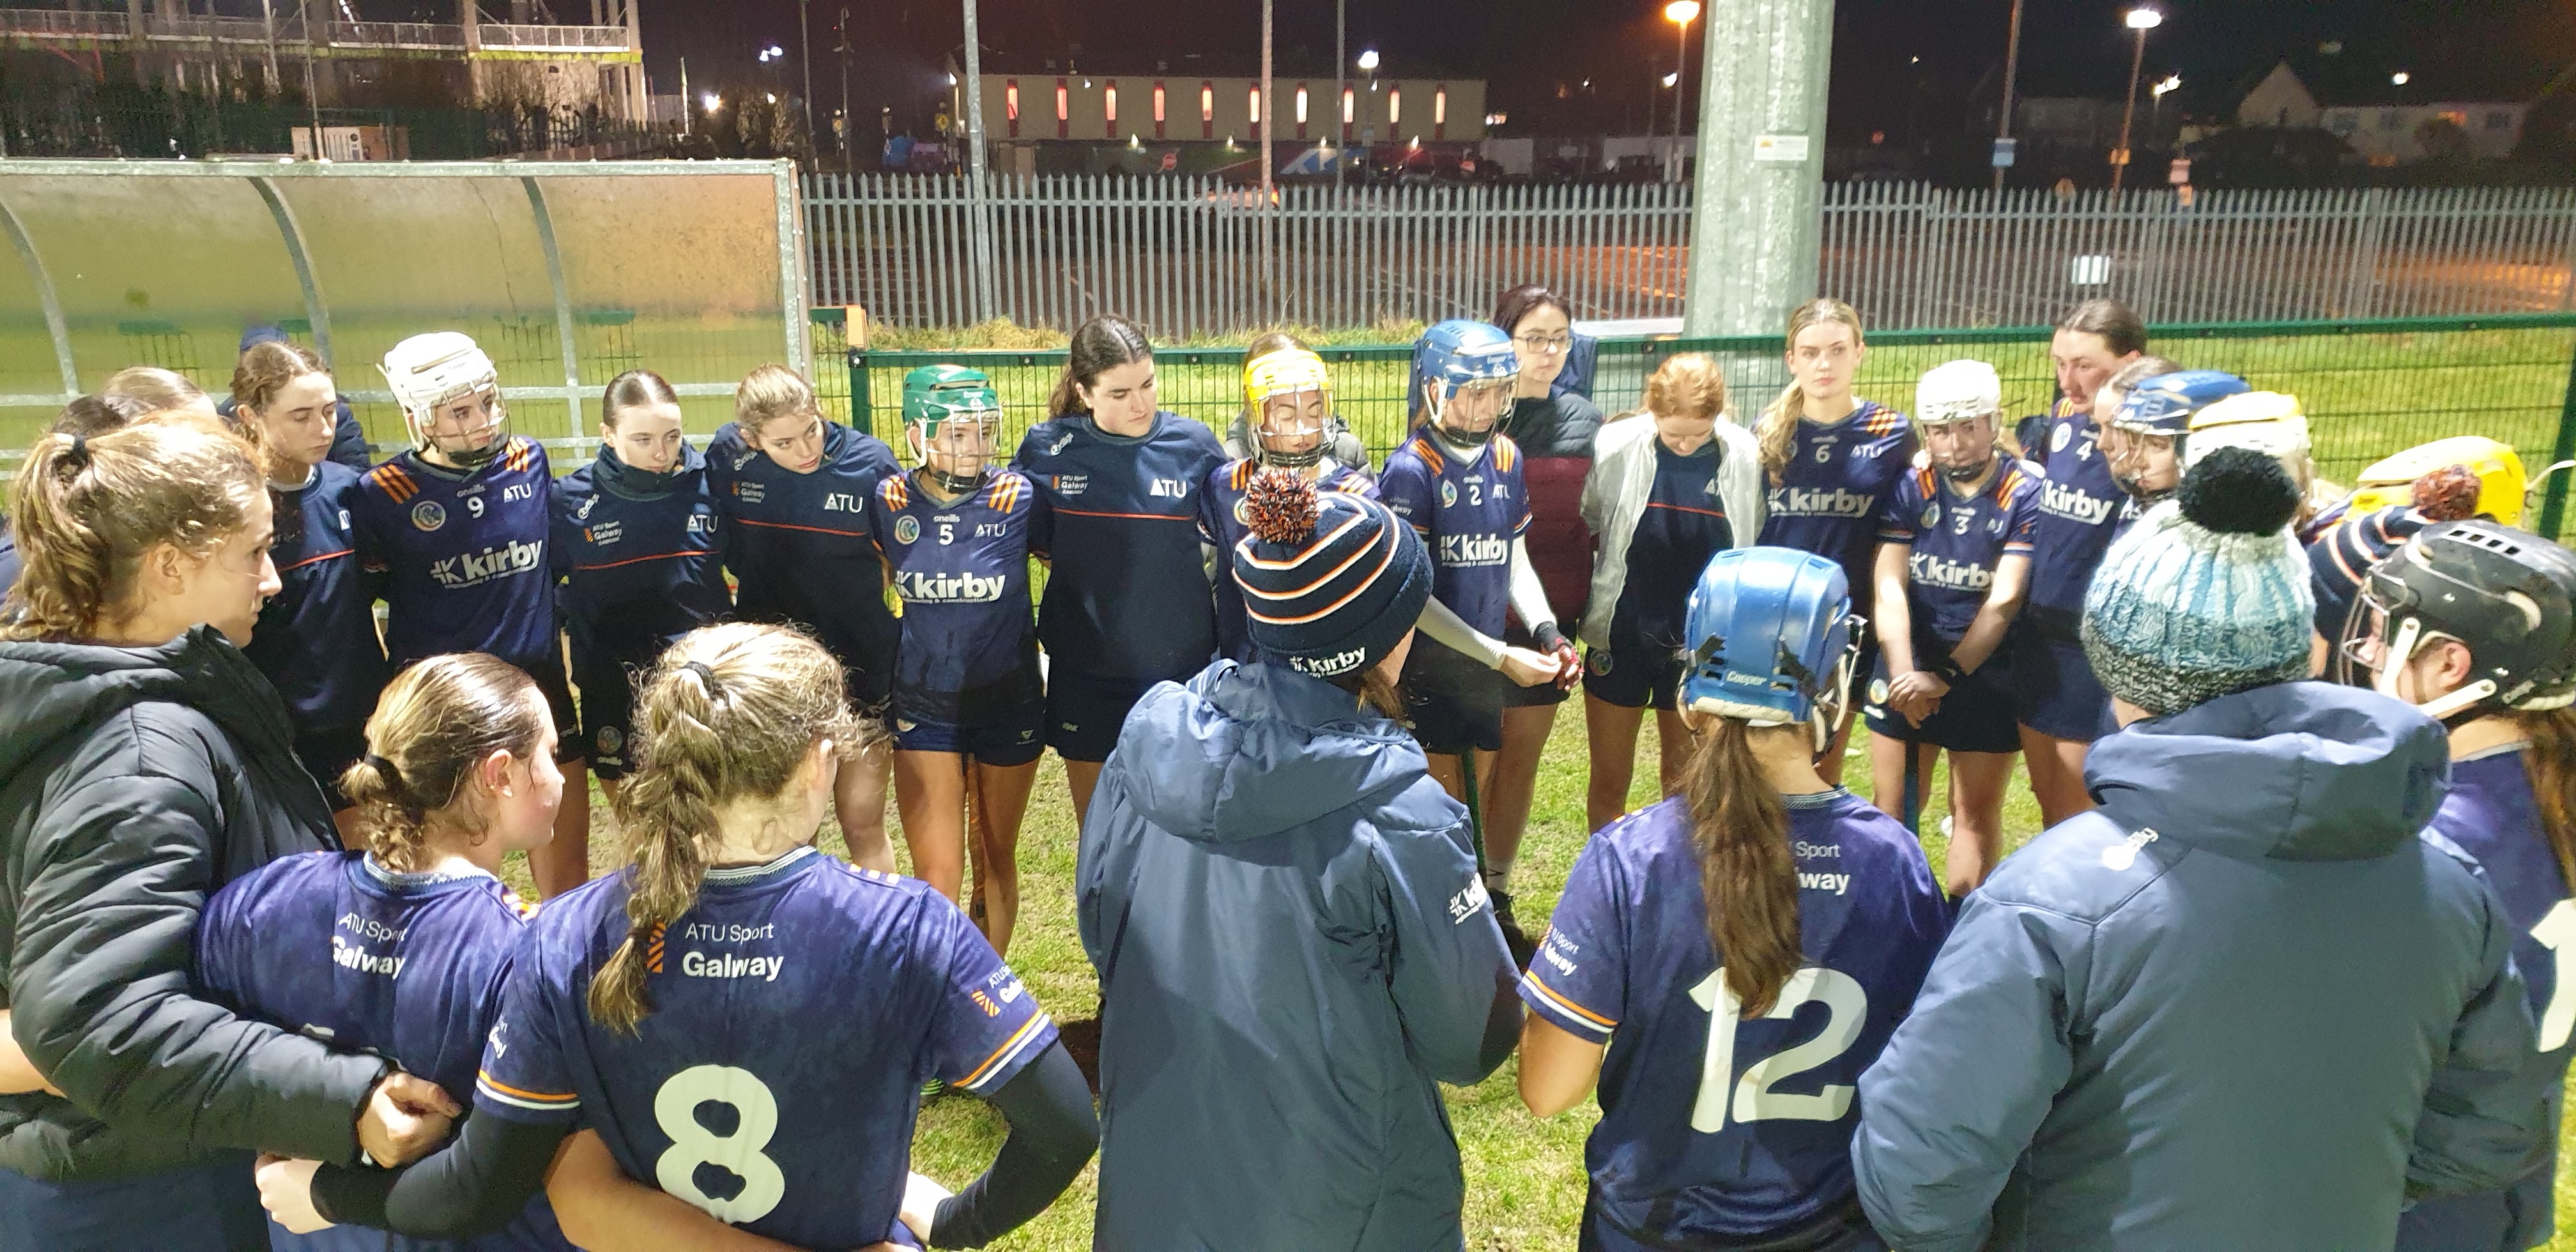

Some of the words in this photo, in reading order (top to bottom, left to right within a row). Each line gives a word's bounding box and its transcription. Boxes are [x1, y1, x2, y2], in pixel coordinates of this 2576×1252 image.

[1815, 444, 1830, 463] 6
[2076, 440, 2093, 461] 4
[503, 482, 532, 503] ATU
[1061, 481, 1089, 491] Galway
[1149, 477, 1187, 498] ATU
[1469, 485, 1482, 506] 2
[467, 496, 484, 519] 9
[824, 492, 863, 514] ATU
[1390, 503, 1413, 516] alway
[1790, 487, 1875, 519] kirby
[2044, 479, 2114, 525] kirby
[686, 514, 719, 534] ATU
[933, 514, 960, 523] oneills
[1953, 515, 1970, 535] 3
[594, 527, 622, 540] Galway
[939, 524, 954, 546] 5
[974, 523, 1007, 538] ATU
[461, 539, 542, 581] kirby
[1462, 532, 1508, 566] kirby
[915, 572, 1006, 602] kirby
[1307, 646, 1365, 673] kirby
[1795, 840, 1841, 860] Sport
[1794, 866, 1851, 896] way
[338, 912, 365, 935] ATU
[685, 922, 726, 942] ATU
[730, 922, 775, 945] Sport
[333, 935, 407, 981] Galway
[682, 950, 785, 982] Galway
[1688, 965, 1868, 1134] 12
[654, 1063, 786, 1225] 8
